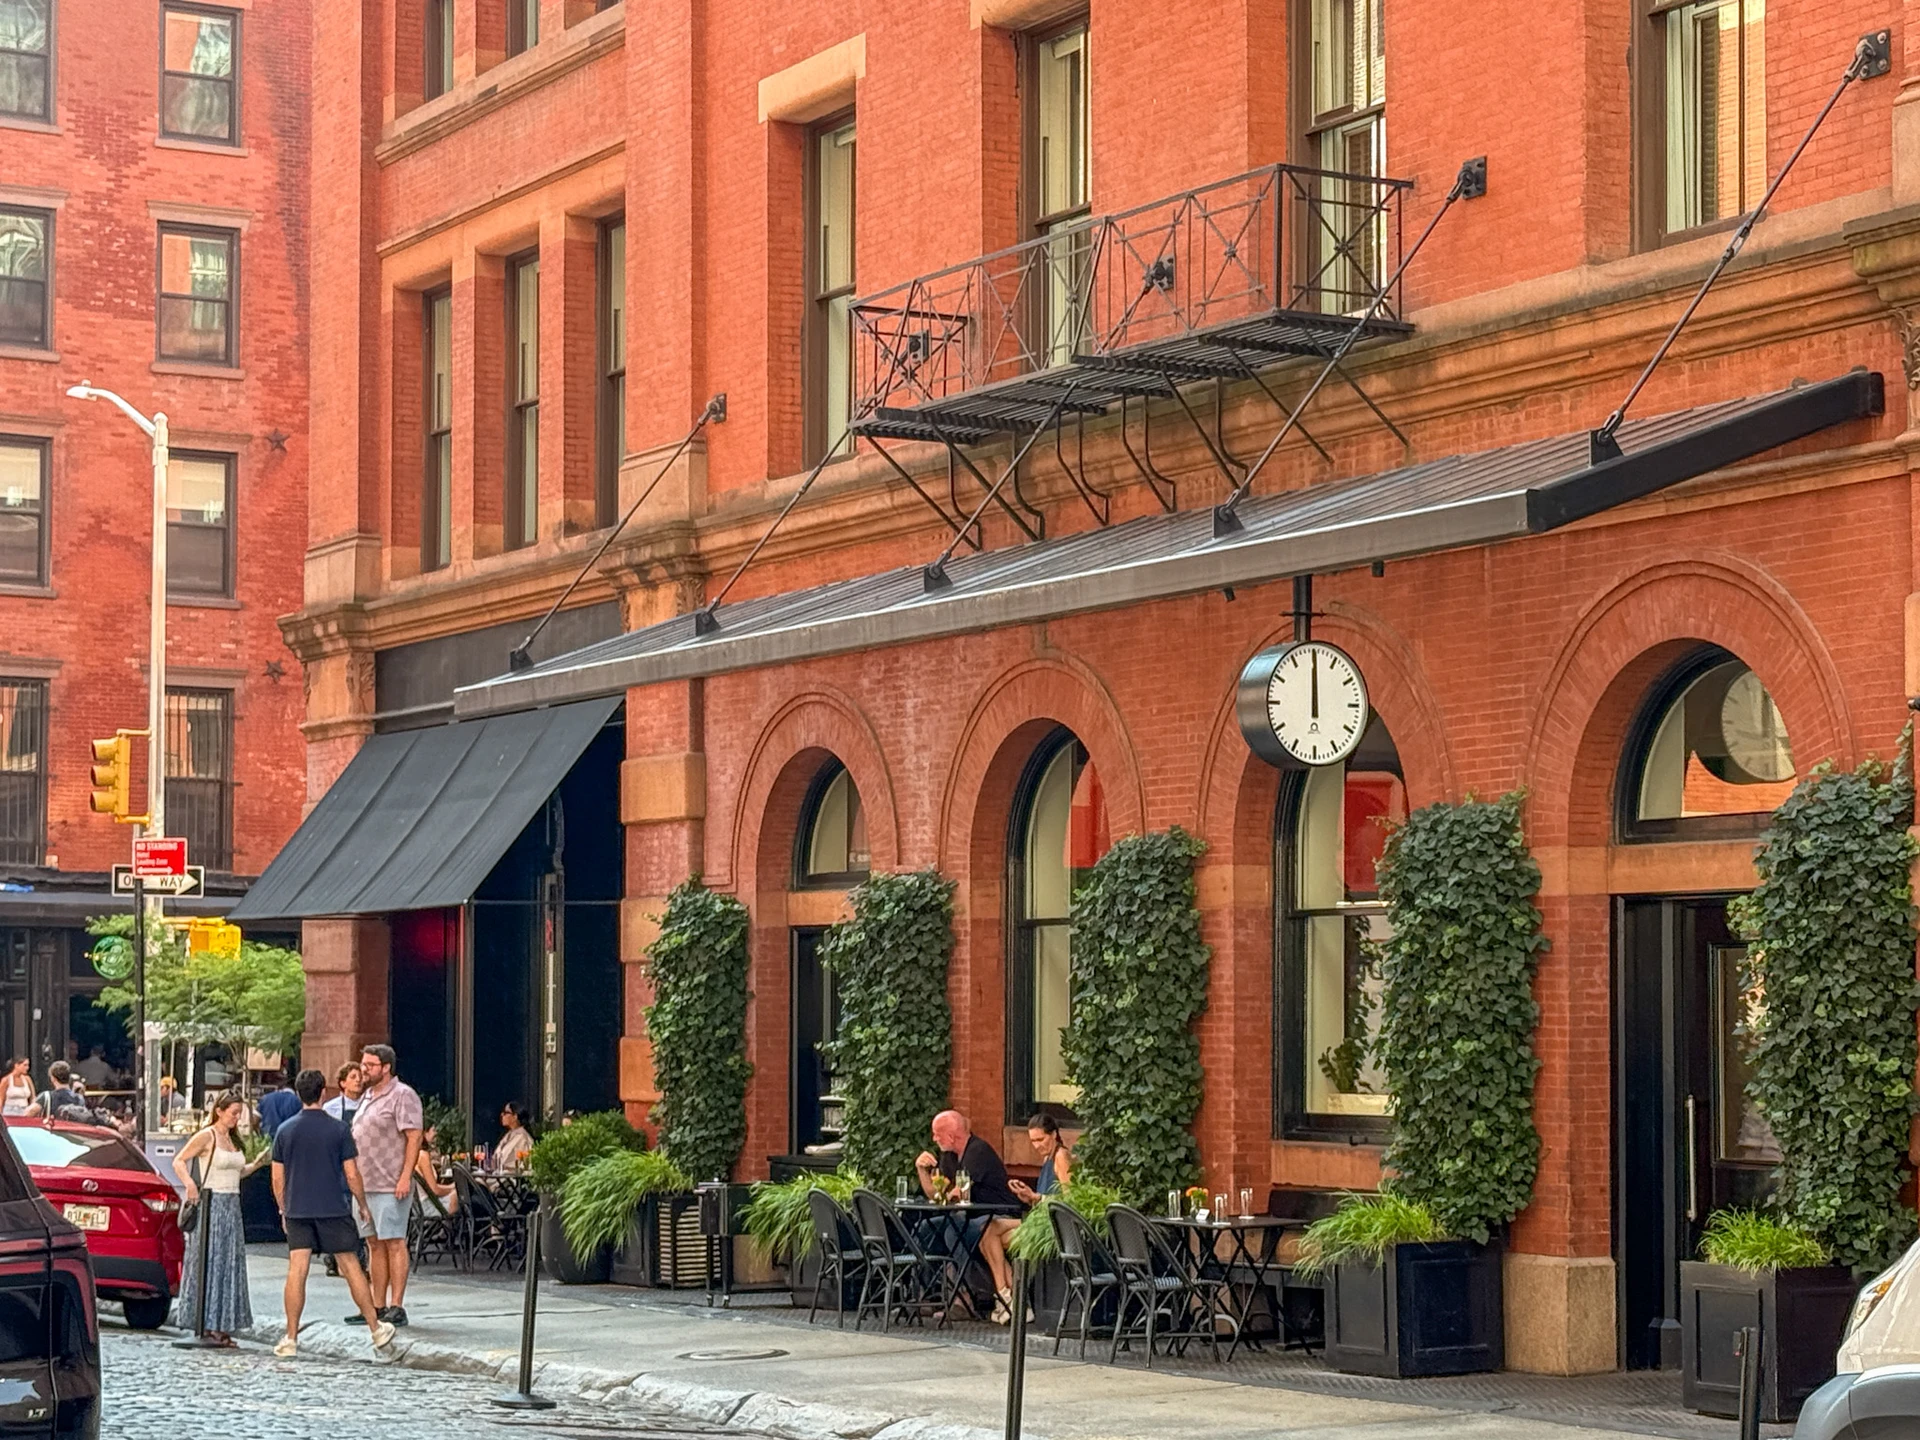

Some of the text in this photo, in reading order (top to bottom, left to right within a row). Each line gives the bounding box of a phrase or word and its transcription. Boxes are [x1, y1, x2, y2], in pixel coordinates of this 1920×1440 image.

[136, 842, 178, 851] NO STANDING
[160, 876, 184, 887] WAY
